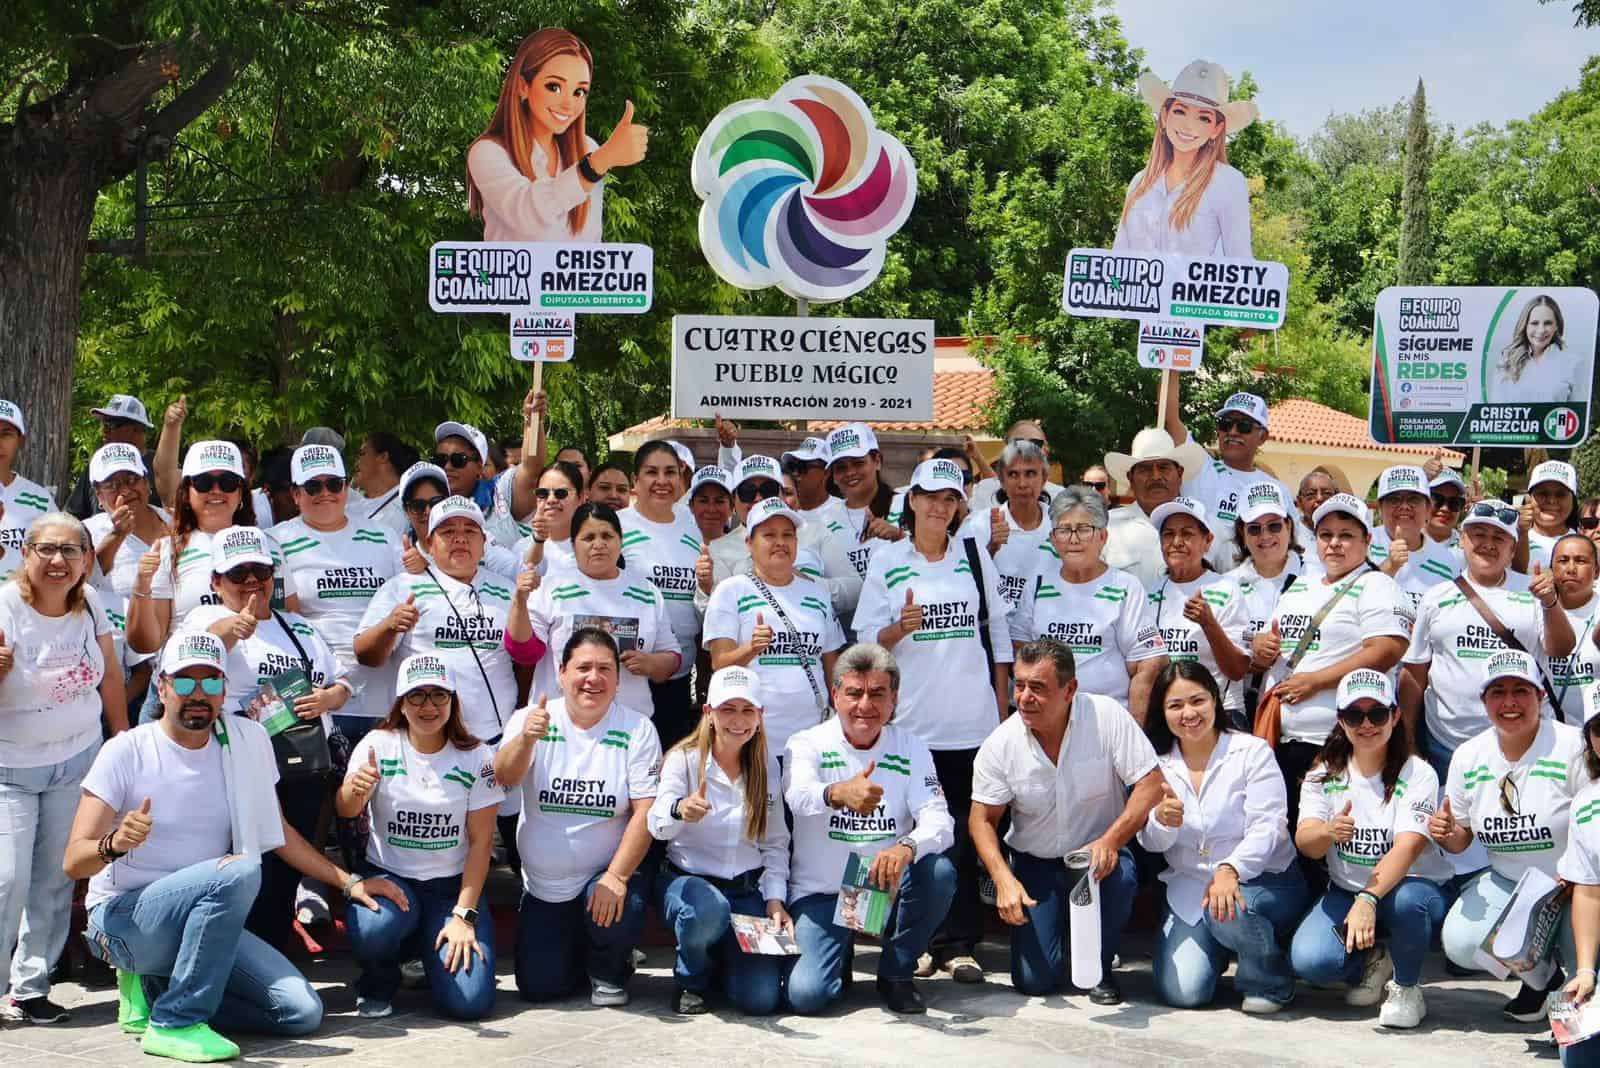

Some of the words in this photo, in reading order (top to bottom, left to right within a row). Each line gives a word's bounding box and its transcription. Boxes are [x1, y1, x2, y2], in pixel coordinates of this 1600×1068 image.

[438, 254, 453, 270] EN
[455, 250, 531, 278] EQUIPO
[556, 250, 633, 270] CRISTY
[1072, 260, 1088, 276] EN
[1090, 256, 1163, 285] EQUIPO
[1188, 262, 1268, 286] CRISTY
[436, 277, 530, 302] COAHUILA
[541, 272, 647, 292] AMEZCUA
[545, 296, 591, 304] DIPUTADA
[593, 296, 635, 304] DISTRITO
[1070, 281, 1160, 310] COAHUILA
[1172, 282, 1280, 308] AMEZCUA
[1175, 306, 1221, 317] DIPUTADA
[1223, 310, 1265, 320] DISTRITO
[1402, 302, 1411, 312] EN
[1414, 299, 1461, 315] EQUIPO
[514, 318, 572, 329] ALIANZA
[1400, 315, 1459, 331] COAHUILA
[1142, 325, 1200, 339] ALIANZA
[1398, 333, 1473, 351] SÍGUEME
[1399, 353, 1412, 361] EN
[1413, 352, 1430, 361] MIS
[1397, 362, 1467, 380] REDES
[700, 394, 829, 408] ADMINISTRACIÓN
[832, 397, 867, 409] 2019
[879, 397, 913, 409] 2021
[1480, 406, 1532, 420] CRISTY
[1470, 419, 1540, 433] AMEZCUA
[1400, 430, 1449, 439] COAHUILA
[325, 567, 374, 577] CRISTY
[317, 577, 386, 589] AMEZCUA
[921, 602, 968, 617] CRISTY
[447, 615, 494, 629] CRISTY
[920, 615, 975, 630] MEZCUA
[1048, 622, 1094, 635] CRISTY
[552, 777, 606, 794] CRISTY
[539, 790, 617, 808] AMEZCUA
[397, 810, 453, 825] CRISTY
[829, 815, 896, 831] AMEZCUA
[1484, 813, 1537, 831] CRISTY
[387, 821, 459, 839] AMEZCUA
[1476, 826, 1552, 846] AMEZCUA
